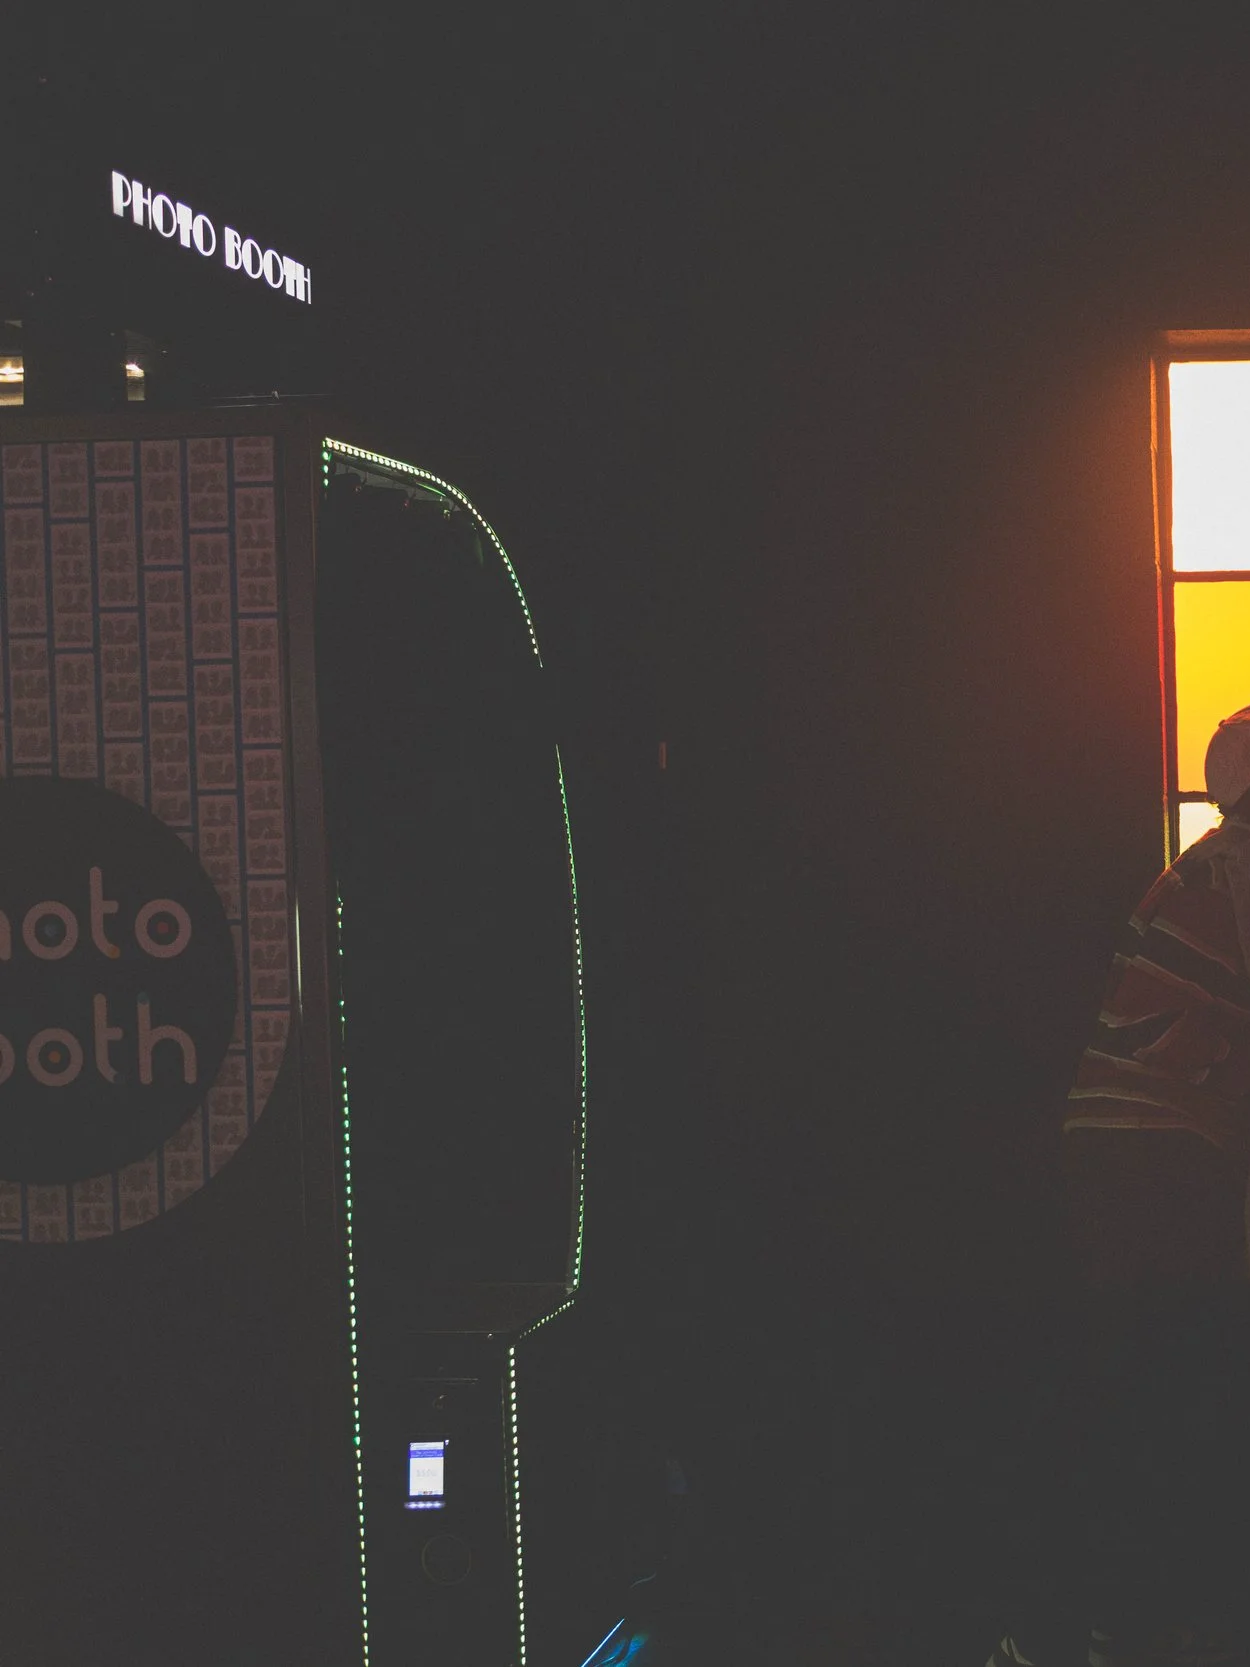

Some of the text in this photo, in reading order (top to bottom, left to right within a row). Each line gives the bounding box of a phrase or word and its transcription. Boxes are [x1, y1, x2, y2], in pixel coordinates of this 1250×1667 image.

[112, 170, 311, 304] PHOTO BOOTH
[0, 866, 192, 960] oto
